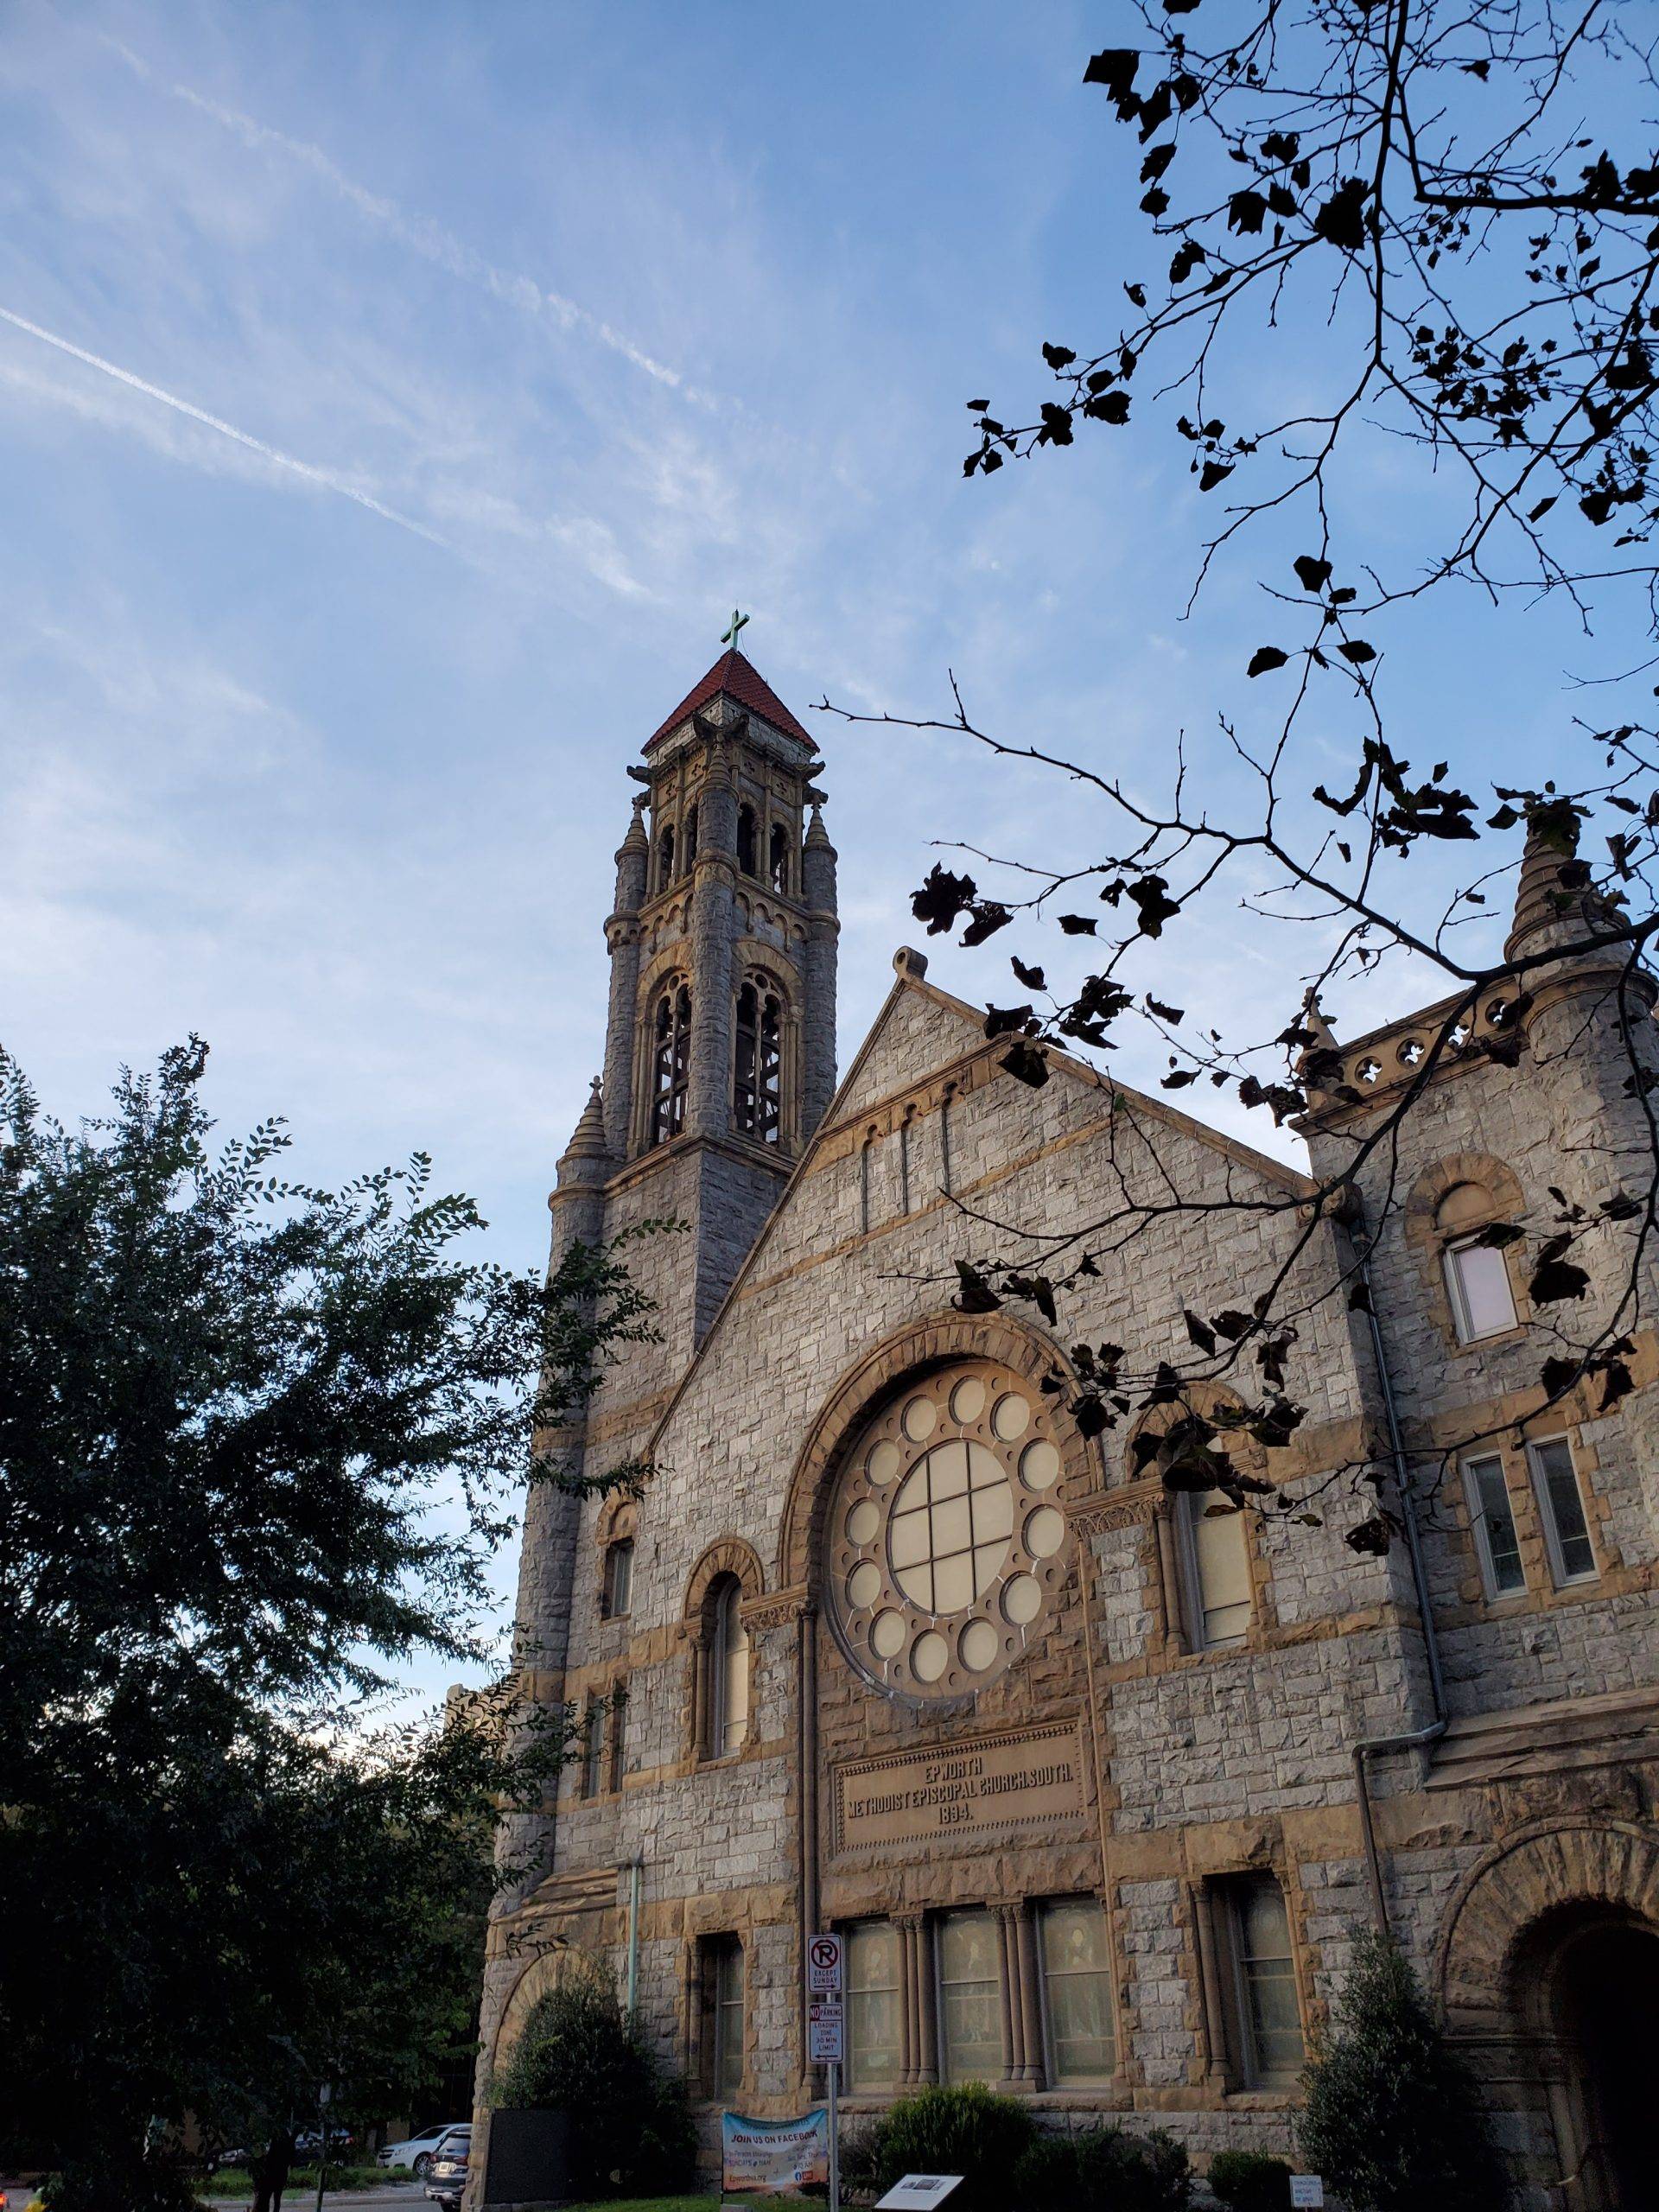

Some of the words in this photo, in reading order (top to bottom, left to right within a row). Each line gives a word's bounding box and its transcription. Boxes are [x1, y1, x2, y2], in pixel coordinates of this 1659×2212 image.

[925, 1757, 982, 1784] EPWORTH
[849, 1791, 910, 1819] METHODIST
[912, 1780, 977, 1808] EPISCOPAL
[810, 2007, 820, 2018] NO
[820, 2008, 842, 2017] PARKING
[731, 2134, 752, 2143] JOIN
